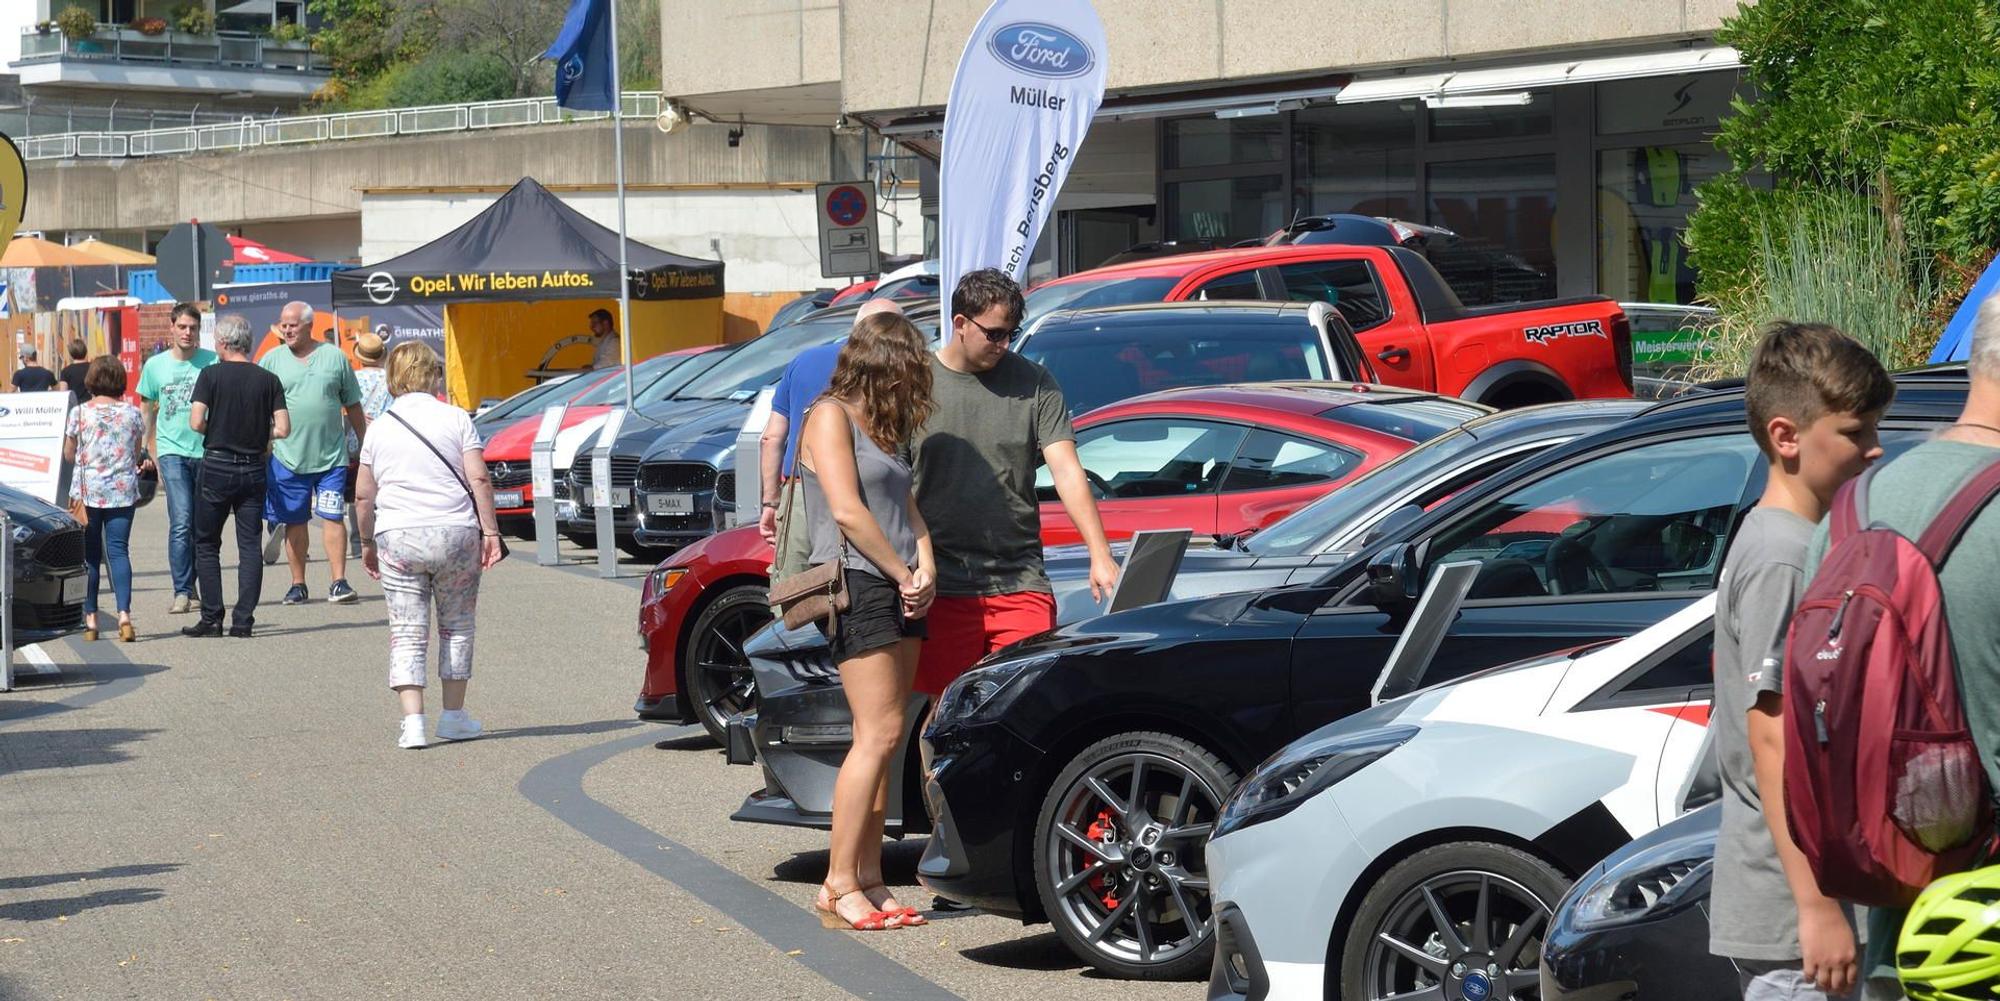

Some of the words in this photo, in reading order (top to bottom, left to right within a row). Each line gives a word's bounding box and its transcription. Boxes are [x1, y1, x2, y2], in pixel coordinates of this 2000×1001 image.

[1011, 29, 1071, 69] Ford
[1010, 85, 1067, 112] Müller
[1017, 139, 1069, 239] Bensberg
[410, 274, 456, 297] Opel.
[458, 273, 487, 291] Wir
[490, 271, 538, 290] leben
[541, 270, 594, 288] Autos.
[229, 290, 289, 304] www.gieraths.de
[394, 326, 447, 338] GIERATHS
[1523, 320, 1607, 346] RAPTOR
[658, 498, 682, 509] S-MAX
